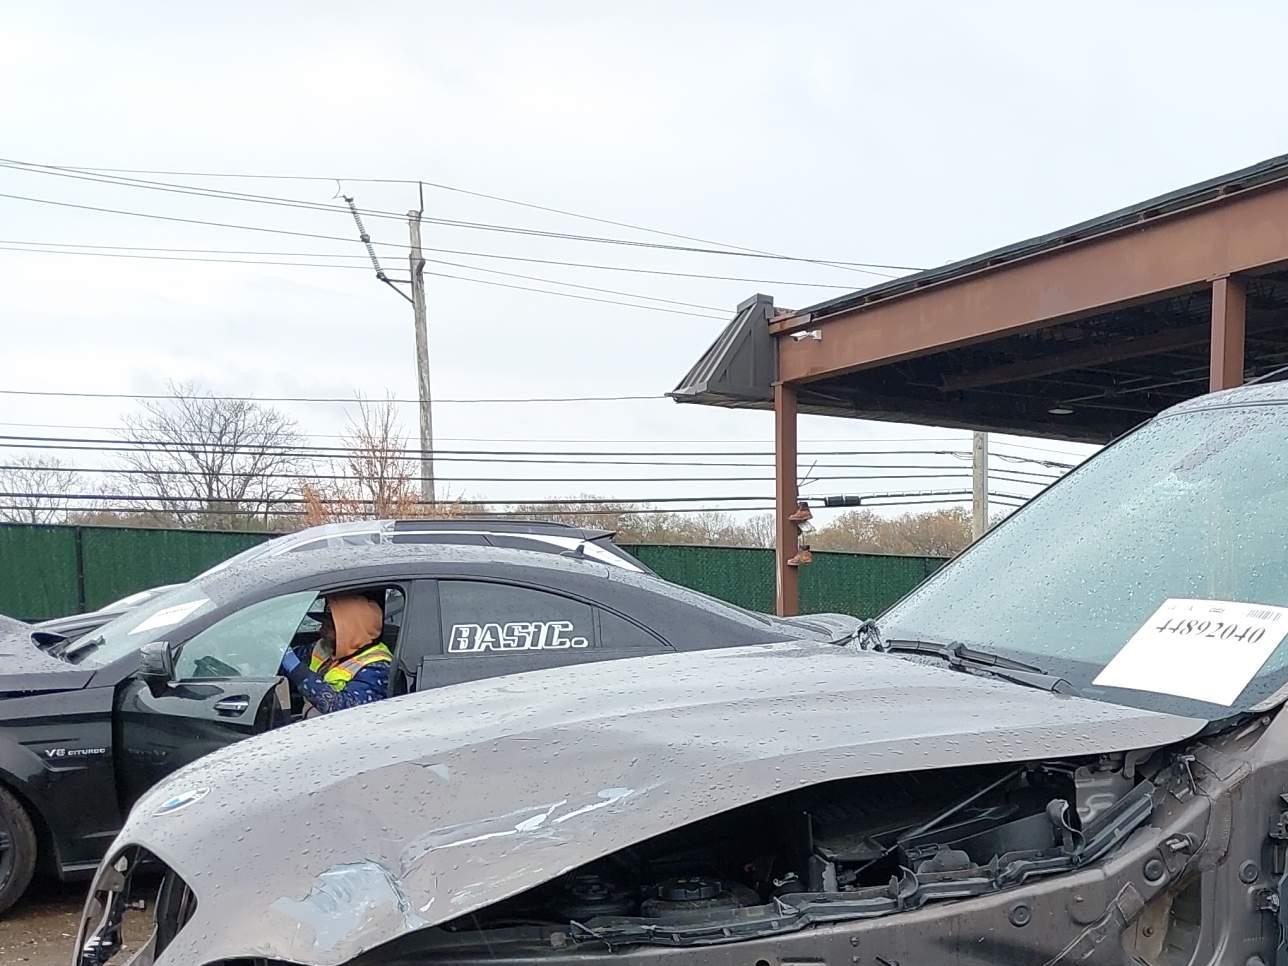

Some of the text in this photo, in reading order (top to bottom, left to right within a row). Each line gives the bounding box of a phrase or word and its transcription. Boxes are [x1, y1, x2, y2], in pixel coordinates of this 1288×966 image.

[448, 621, 588, 652] BASIC.
[1156, 617, 1266, 644] 44892040
[44, 747, 66, 757] V8
